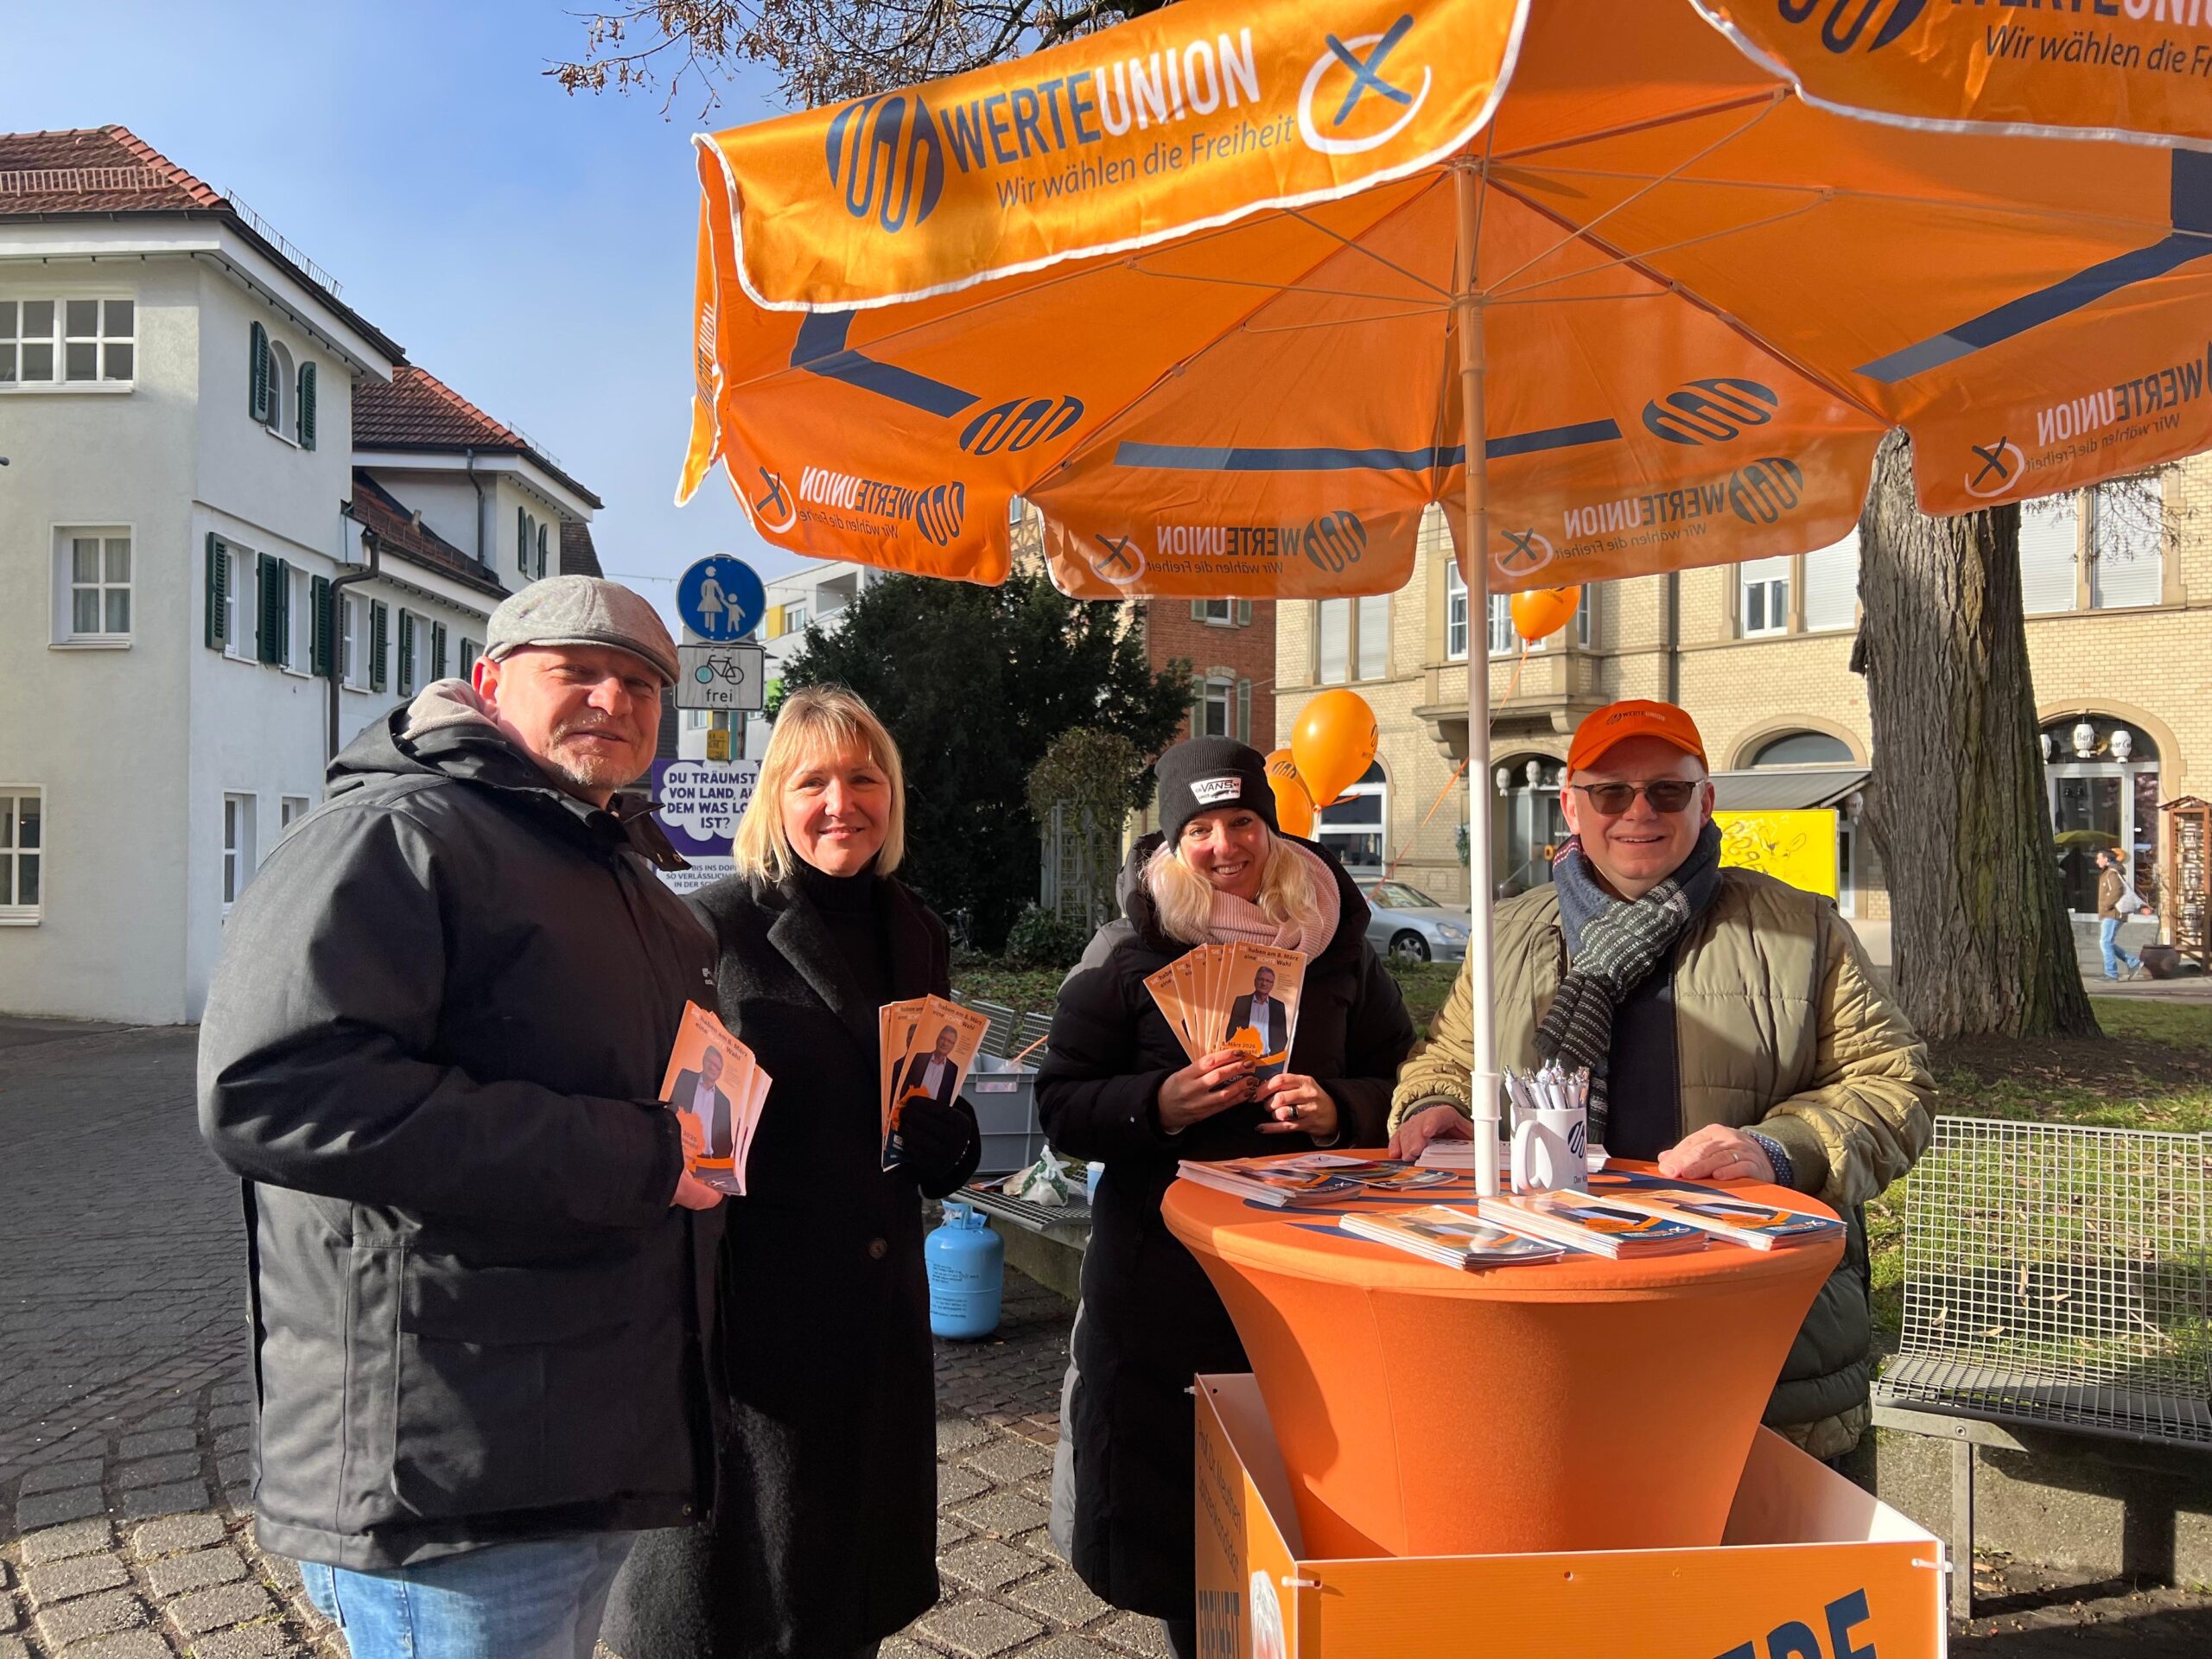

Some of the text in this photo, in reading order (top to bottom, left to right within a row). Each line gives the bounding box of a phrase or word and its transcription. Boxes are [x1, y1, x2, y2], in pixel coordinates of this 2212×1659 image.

[1986, 24, 2034, 59] Wir
[2040, 30, 2140, 69] wählen
[2146, 39, 2187, 73] die
[940, 28, 1261, 173] WERTEUNION
[996, 113, 1295, 208] Wir wählen die Freiheit
[706, 689, 734, 702] frei
[669, 770, 757, 785] DU TRÄUMST
[1201, 779, 1234, 793] VANS
[670, 787, 695, 799] VON
[699, 787, 735, 801] LAND,
[667, 802, 694, 814] DEM
[698, 802, 728, 814] WAS
[701, 817, 730, 830] IST?
[1276, 959, 1292, 968] Wahl
